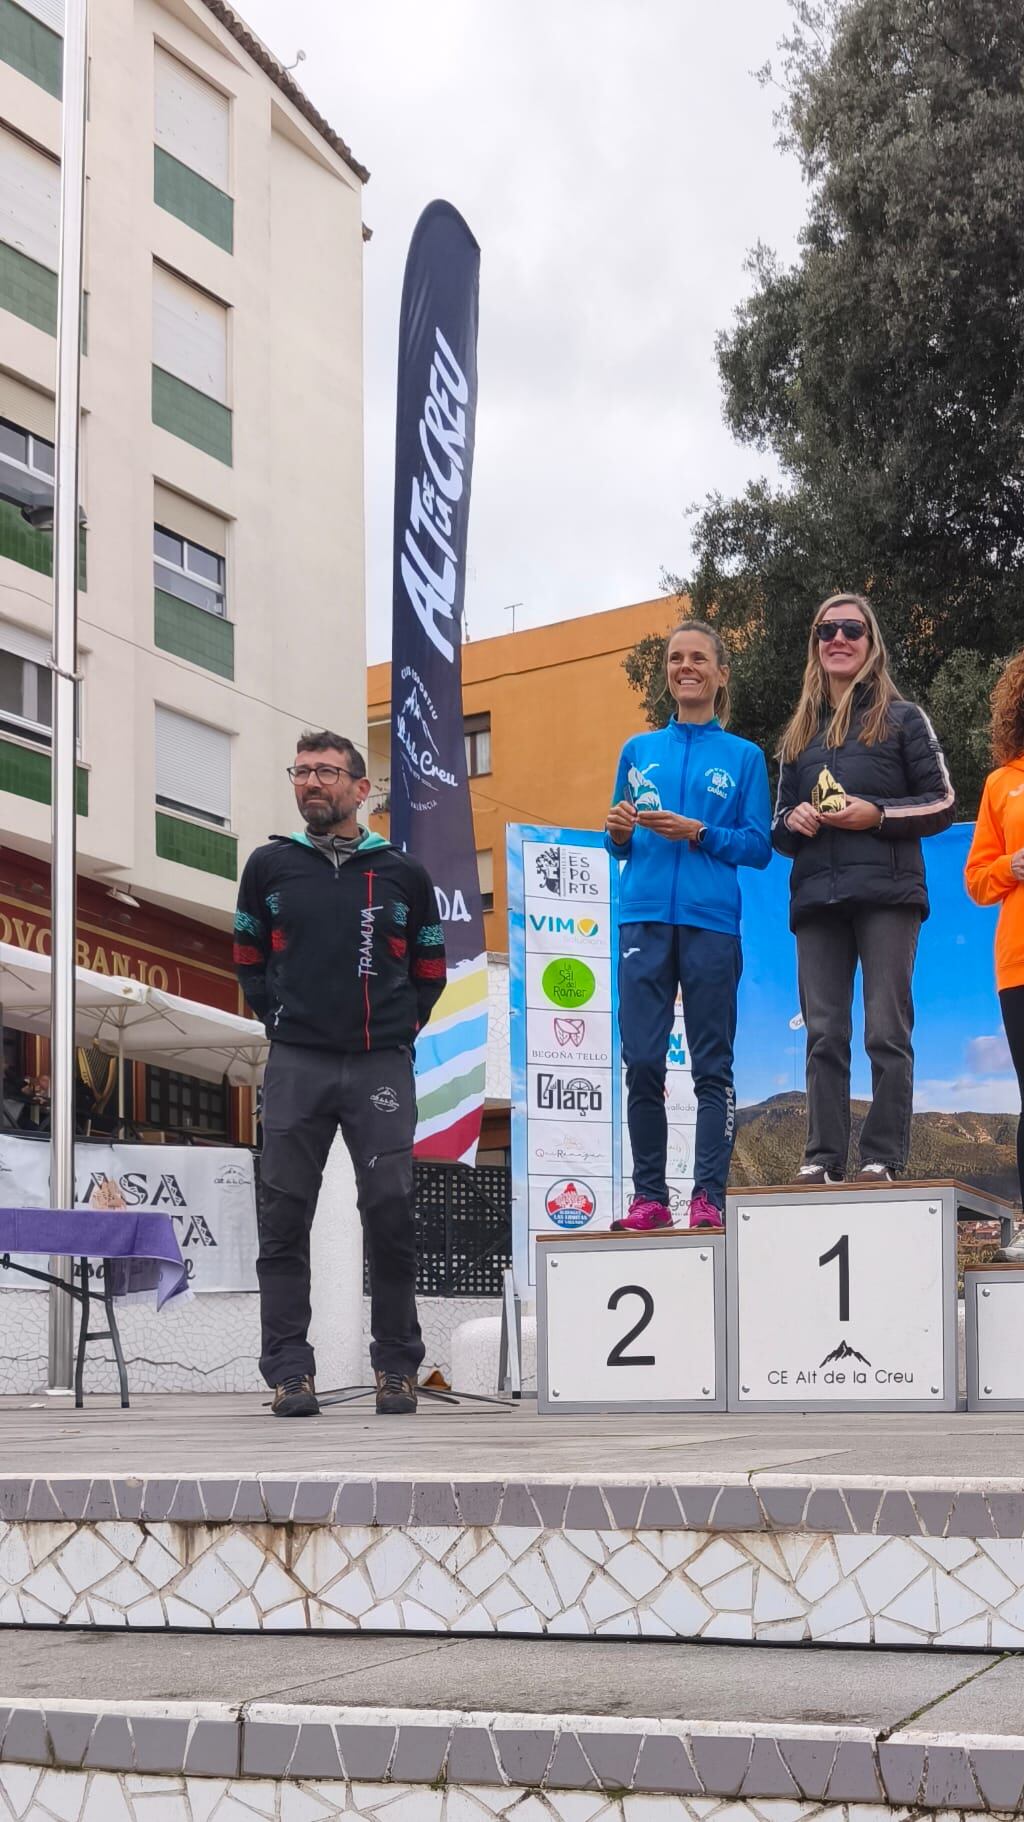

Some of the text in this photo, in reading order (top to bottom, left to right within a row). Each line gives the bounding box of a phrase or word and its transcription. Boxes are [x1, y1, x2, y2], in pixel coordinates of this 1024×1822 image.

[419, 326, 469, 502] CREU
[401, 476, 458, 664] ALT
[420, 751, 459, 787] Creu
[569, 856, 590, 868] ES
[569, 868, 591, 881] PO
[569, 882, 599, 896] RTS
[358, 906, 384, 978] TRAMUVA
[532, 1050, 608, 1061] BEGOÑA TELLO
[818, 1234, 850, 1322] 1
[606, 1285, 656, 1367] 2
[767, 1370, 914, 1384] CE Alt de la Creu
